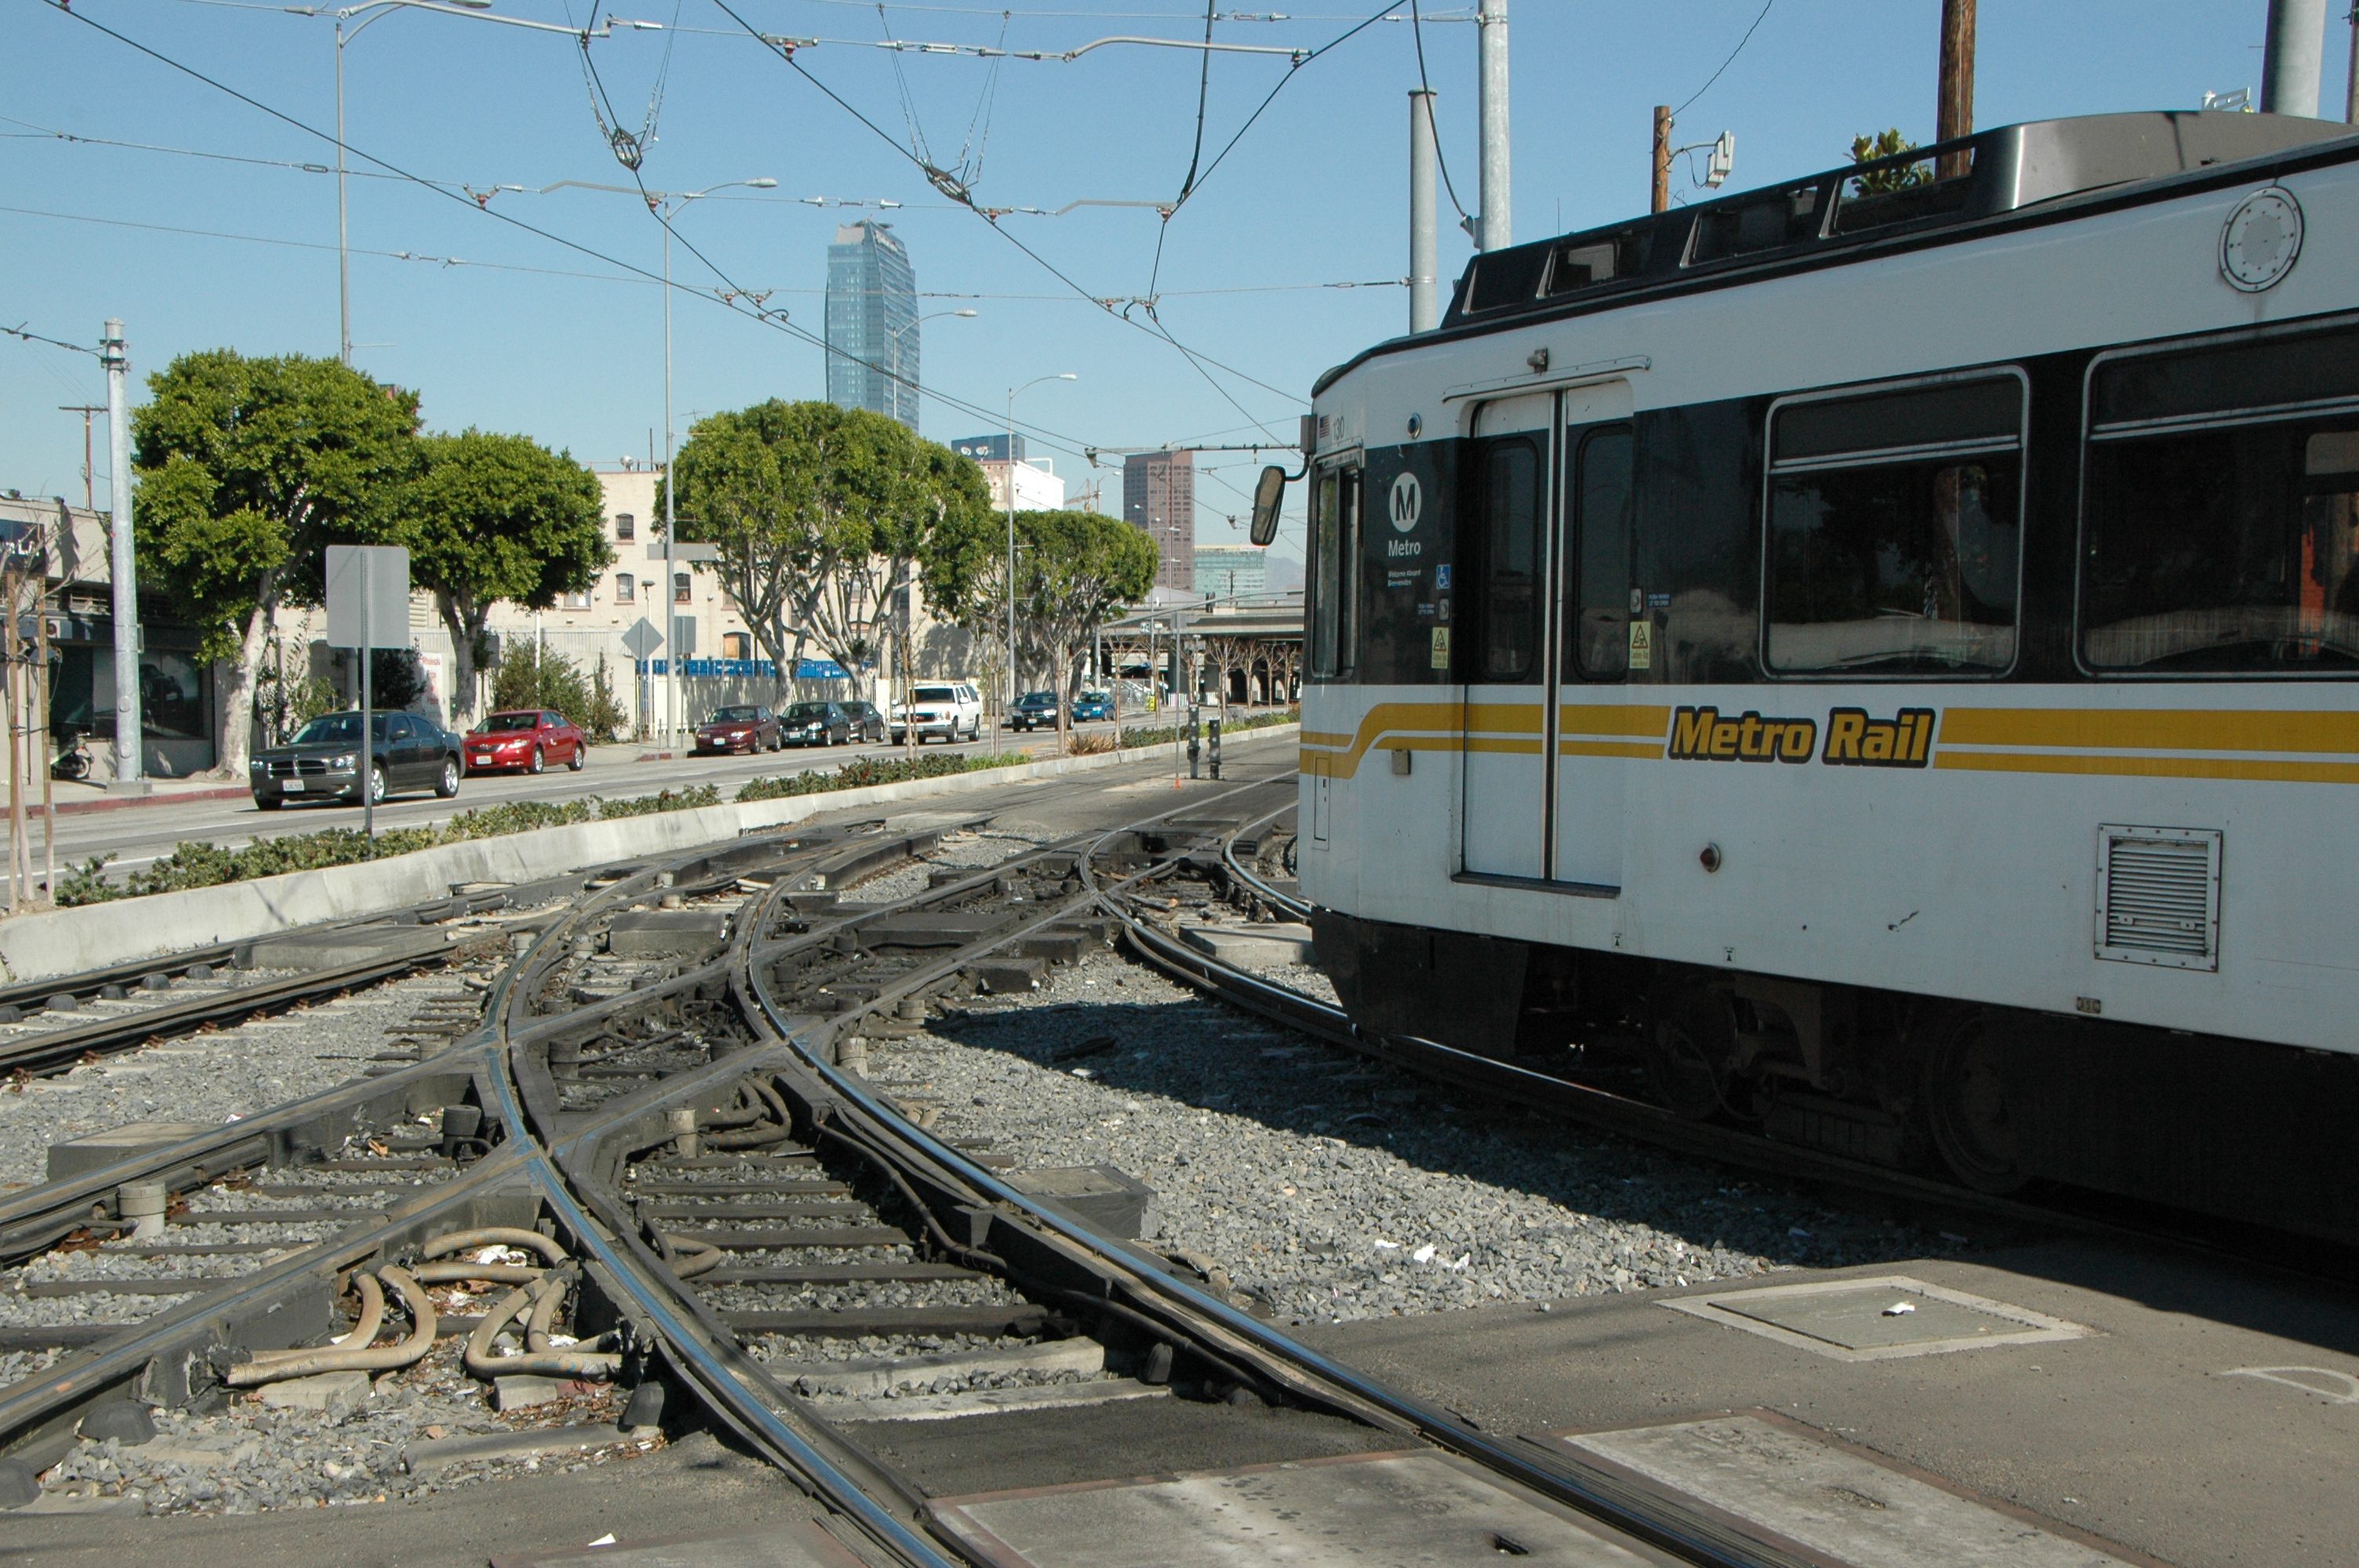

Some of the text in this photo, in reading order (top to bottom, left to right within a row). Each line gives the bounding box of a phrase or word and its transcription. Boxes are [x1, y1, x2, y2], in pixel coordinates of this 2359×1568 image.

[1395, 483, 1416, 521] M
[1388, 539, 1421, 557] Metro
[1669, 706, 1936, 768] Metro Rail
